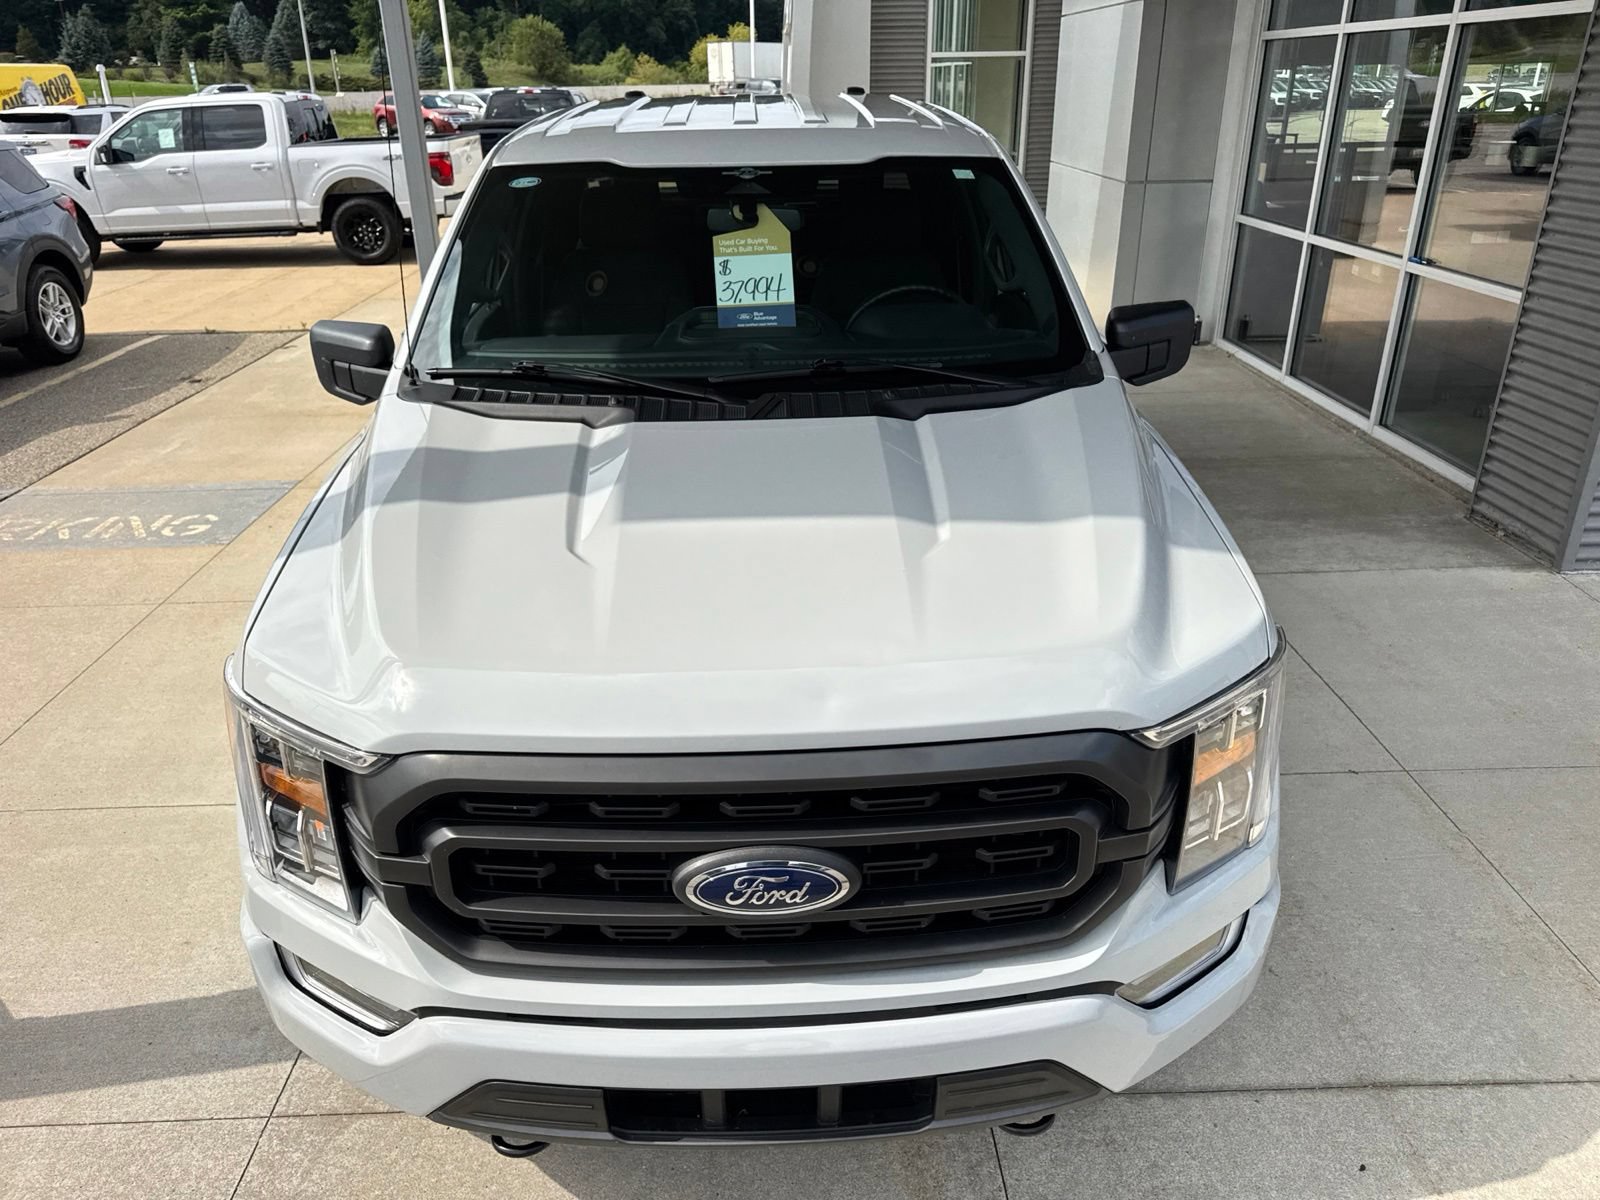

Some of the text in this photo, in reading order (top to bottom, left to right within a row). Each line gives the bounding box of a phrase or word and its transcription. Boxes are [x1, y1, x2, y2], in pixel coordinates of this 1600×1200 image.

[39, 73, 75, 106] HOUR
[735, 238, 746, 246] Car
[719, 259, 731, 276] $
[725, 875, 811, 906] Ford
